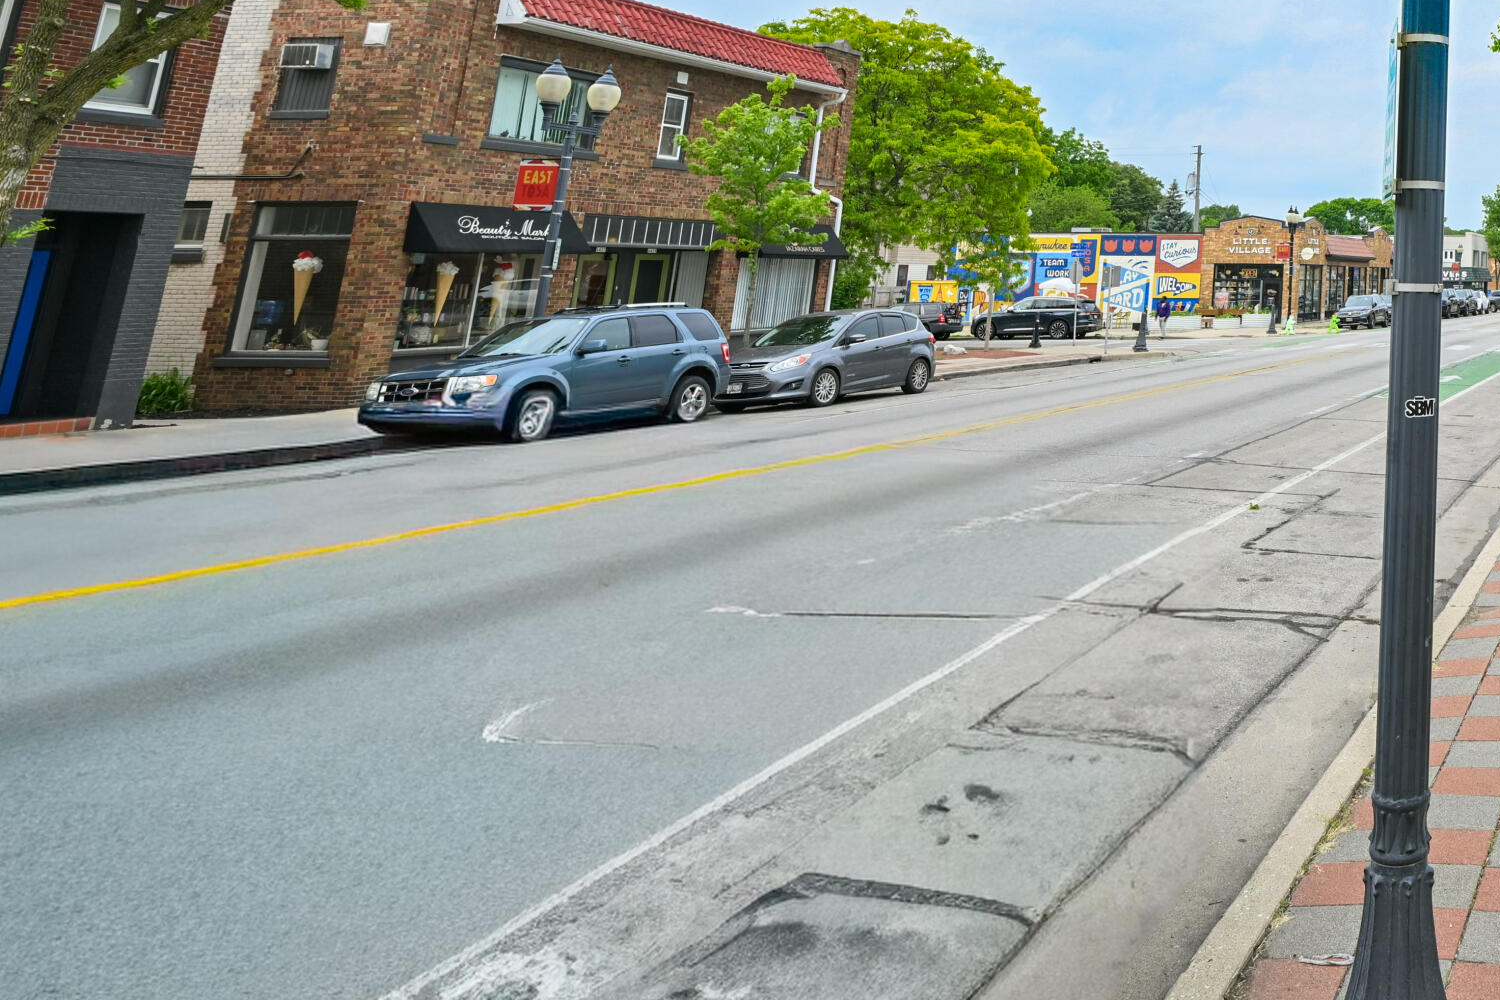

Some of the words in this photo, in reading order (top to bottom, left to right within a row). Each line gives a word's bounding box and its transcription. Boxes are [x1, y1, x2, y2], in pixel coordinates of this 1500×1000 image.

[523, 170, 554, 184] EAST
[521, 184, 550, 198] TOSA
[458, 215, 512, 237] Beauty
[1162, 242, 1178, 251] STAY
[1110, 288, 1144, 308] HARD
